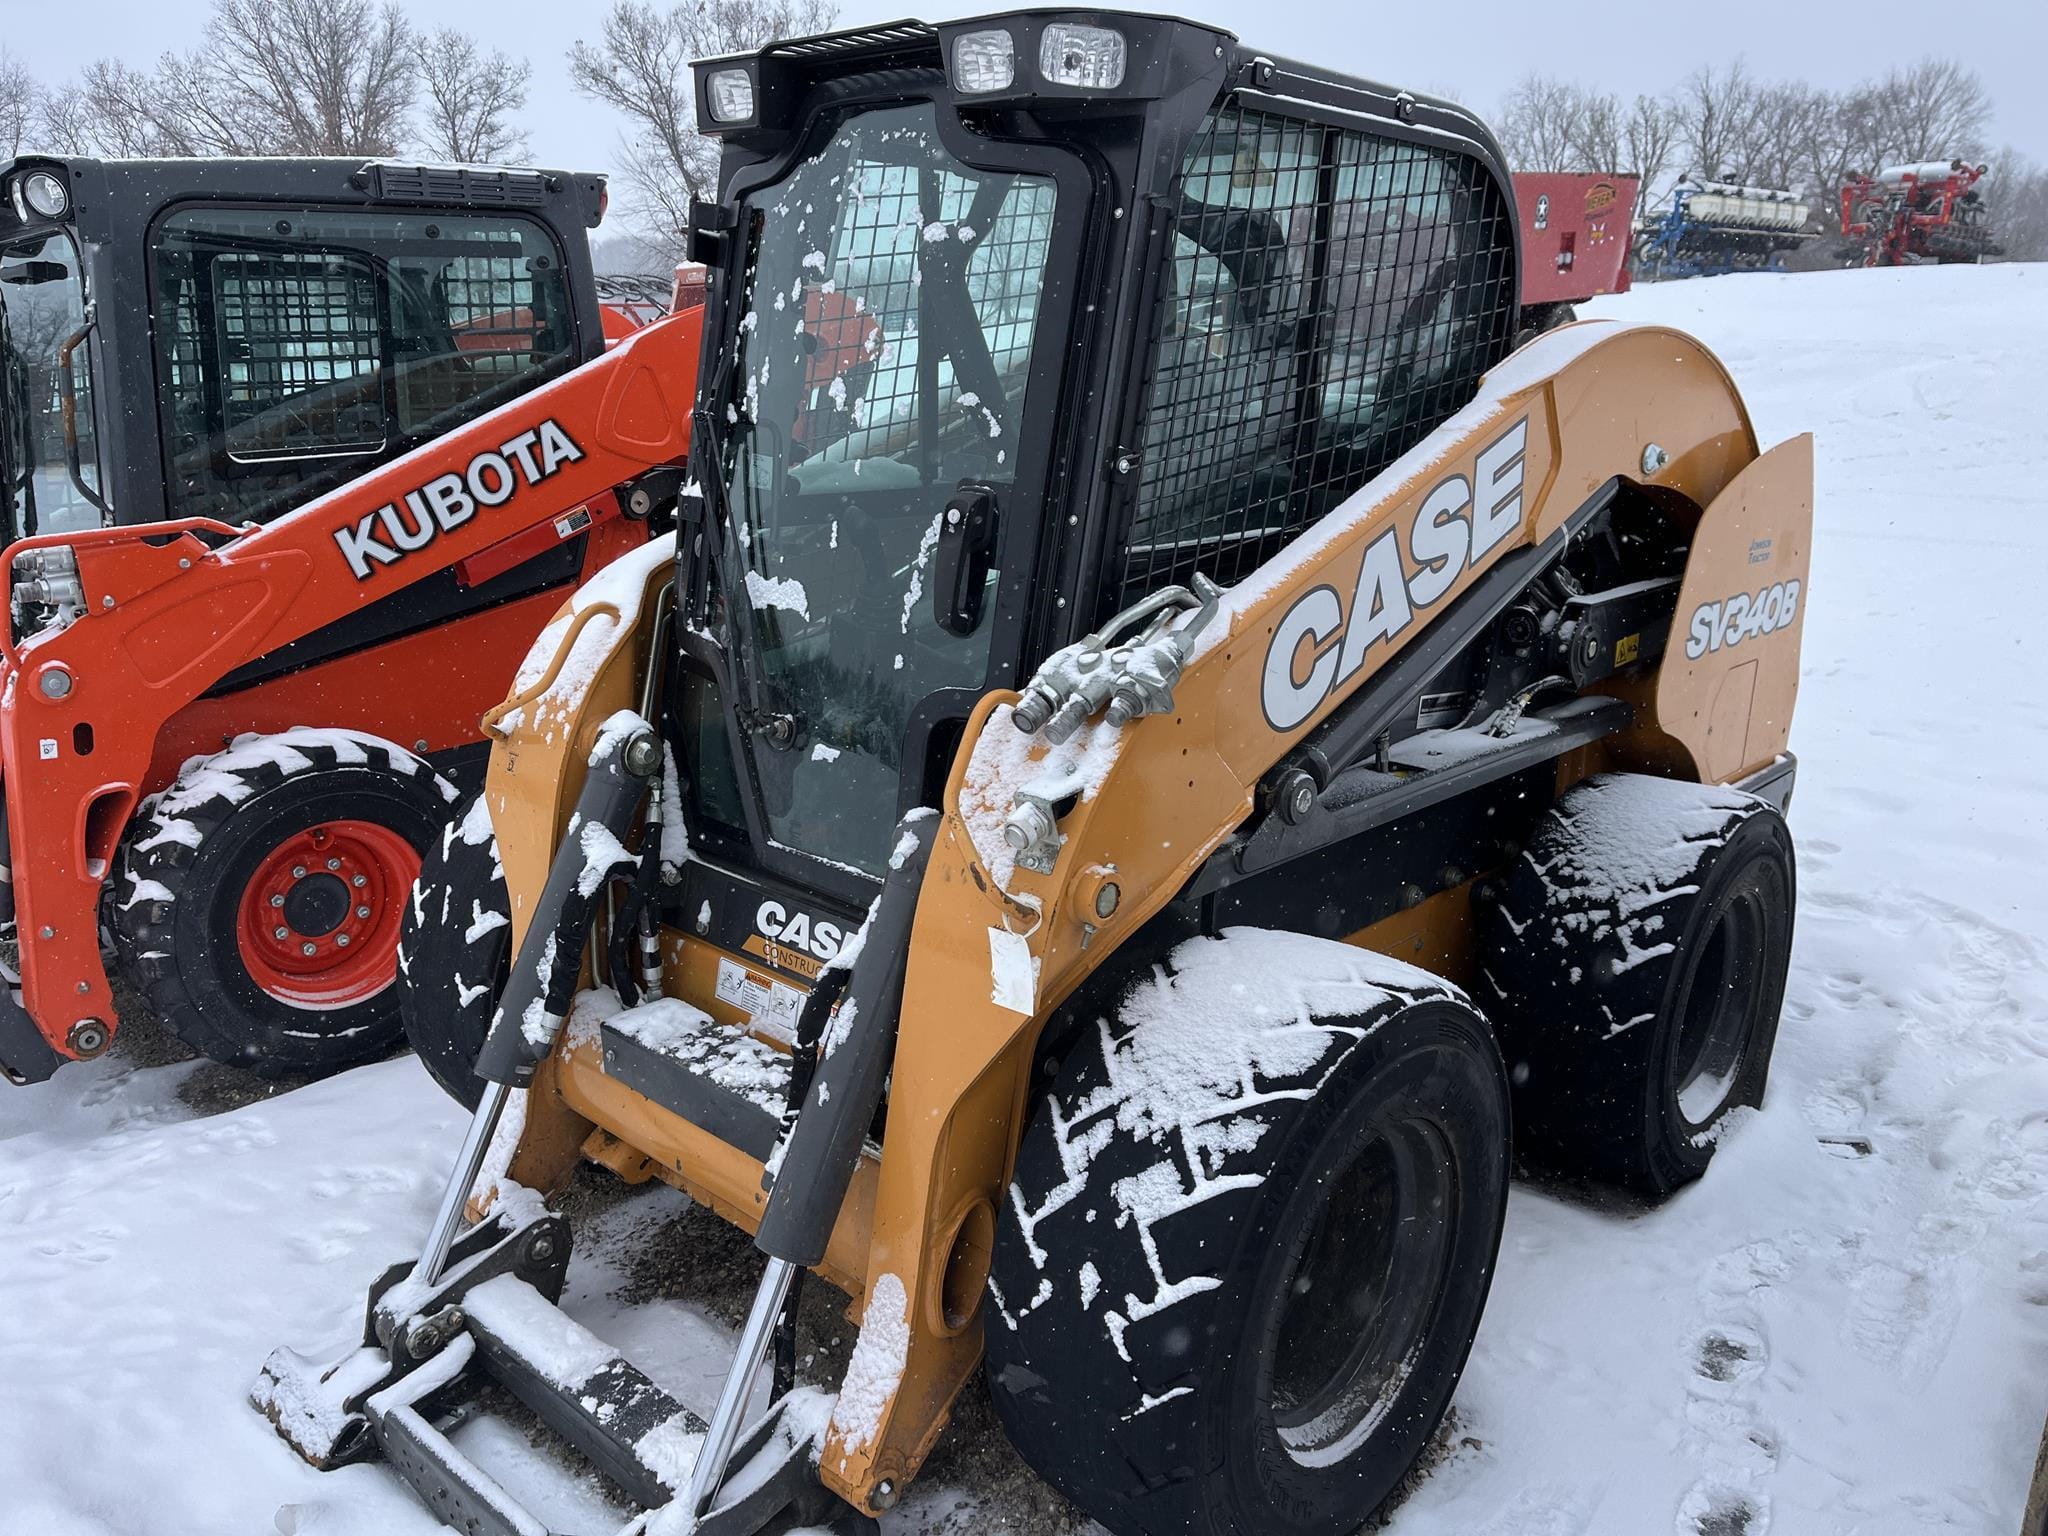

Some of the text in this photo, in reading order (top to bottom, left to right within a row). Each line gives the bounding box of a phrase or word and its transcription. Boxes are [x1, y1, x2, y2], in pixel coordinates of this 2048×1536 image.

[333, 419, 584, 580] KUBOTA
[1261, 414, 1528, 733] CASE
[1685, 578, 1801, 660] SV340B
